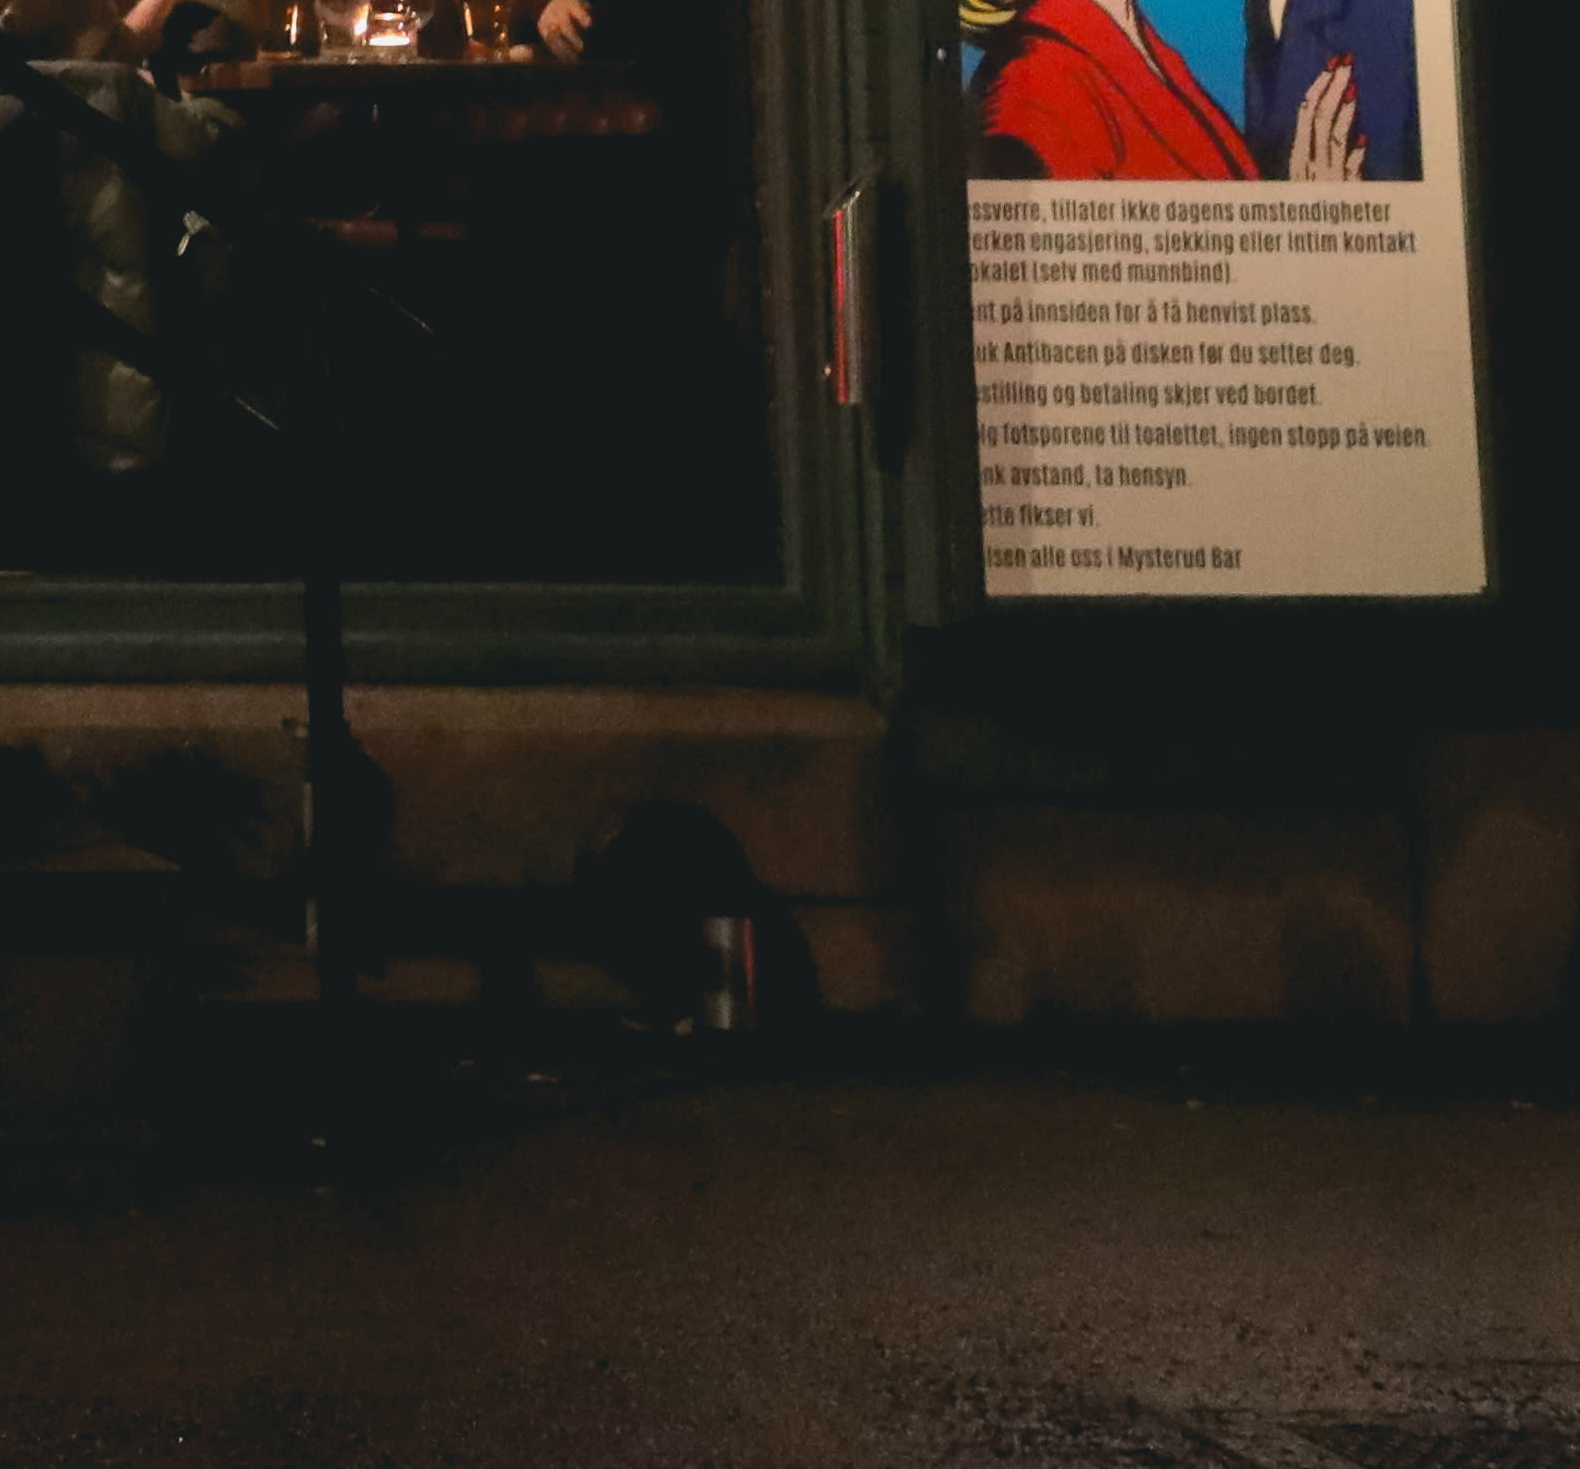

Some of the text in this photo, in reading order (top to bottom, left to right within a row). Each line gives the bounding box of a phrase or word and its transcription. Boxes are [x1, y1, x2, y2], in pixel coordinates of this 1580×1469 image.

[969, 199, 1392, 223] ssverre, tillater ikke dagens omstendigheter
[971, 230, 1026, 254] erken
[1031, 230, 1150, 254] engasjering,
[1154, 230, 1235, 254] sjekking
[1239, 230, 1282, 254] eller
[1343, 230, 1418, 254] kontakt
[1032, 260, 1078, 284] (selv
[1082, 260, 1123, 284] med
[973, 298, 996, 324] nt
[1001, 298, 1024, 324] på
[1028, 298, 1111, 324] innsiden
[1115, 298, 1141, 324] for
[1147, 298, 1158, 324] å
[1163, 298, 1181, 324] få
[1185, 298, 1257, 324] henvist
[975, 341, 998, 364] uk
[1103, 341, 1126, 364] på
[1131, 341, 1194, 364] disken
[1199, 341, 1224, 364] før
[1229, 341, 1254, 364] du
[1258, 341, 1314, 364] setter
[976, 382, 1048, 407] stilling
[1052, 382, 1076, 407] og
[1080, 382, 1159, 407] betaling
[1164, 382, 1210, 407] skjer
[1215, 382, 1249, 407] ved
[979, 423, 998, 448] lg
[1003, 423, 1106, 448] fotsporene
[1110, 423, 1130, 448] til
[1135, 423, 1225, 448] toalettet,
[1229, 423, 1282, 448] ingen
[1287, 423, 1341, 448] stopp
[1346, 423, 1369, 448] på
[981, 464, 1007, 488] nk
[1011, 464, 1092, 488] avstand,
[1095, 464, 1114, 488] ta
[1019, 504, 1073, 527] fikser
[987, 546, 1026, 569] lsen
[1029, 546, 1066, 569] alle
[1070, 546, 1103, 569] oss
[1117, 546, 1206, 569] Mysterud
[1211, 546, 1242, 569] Bar
